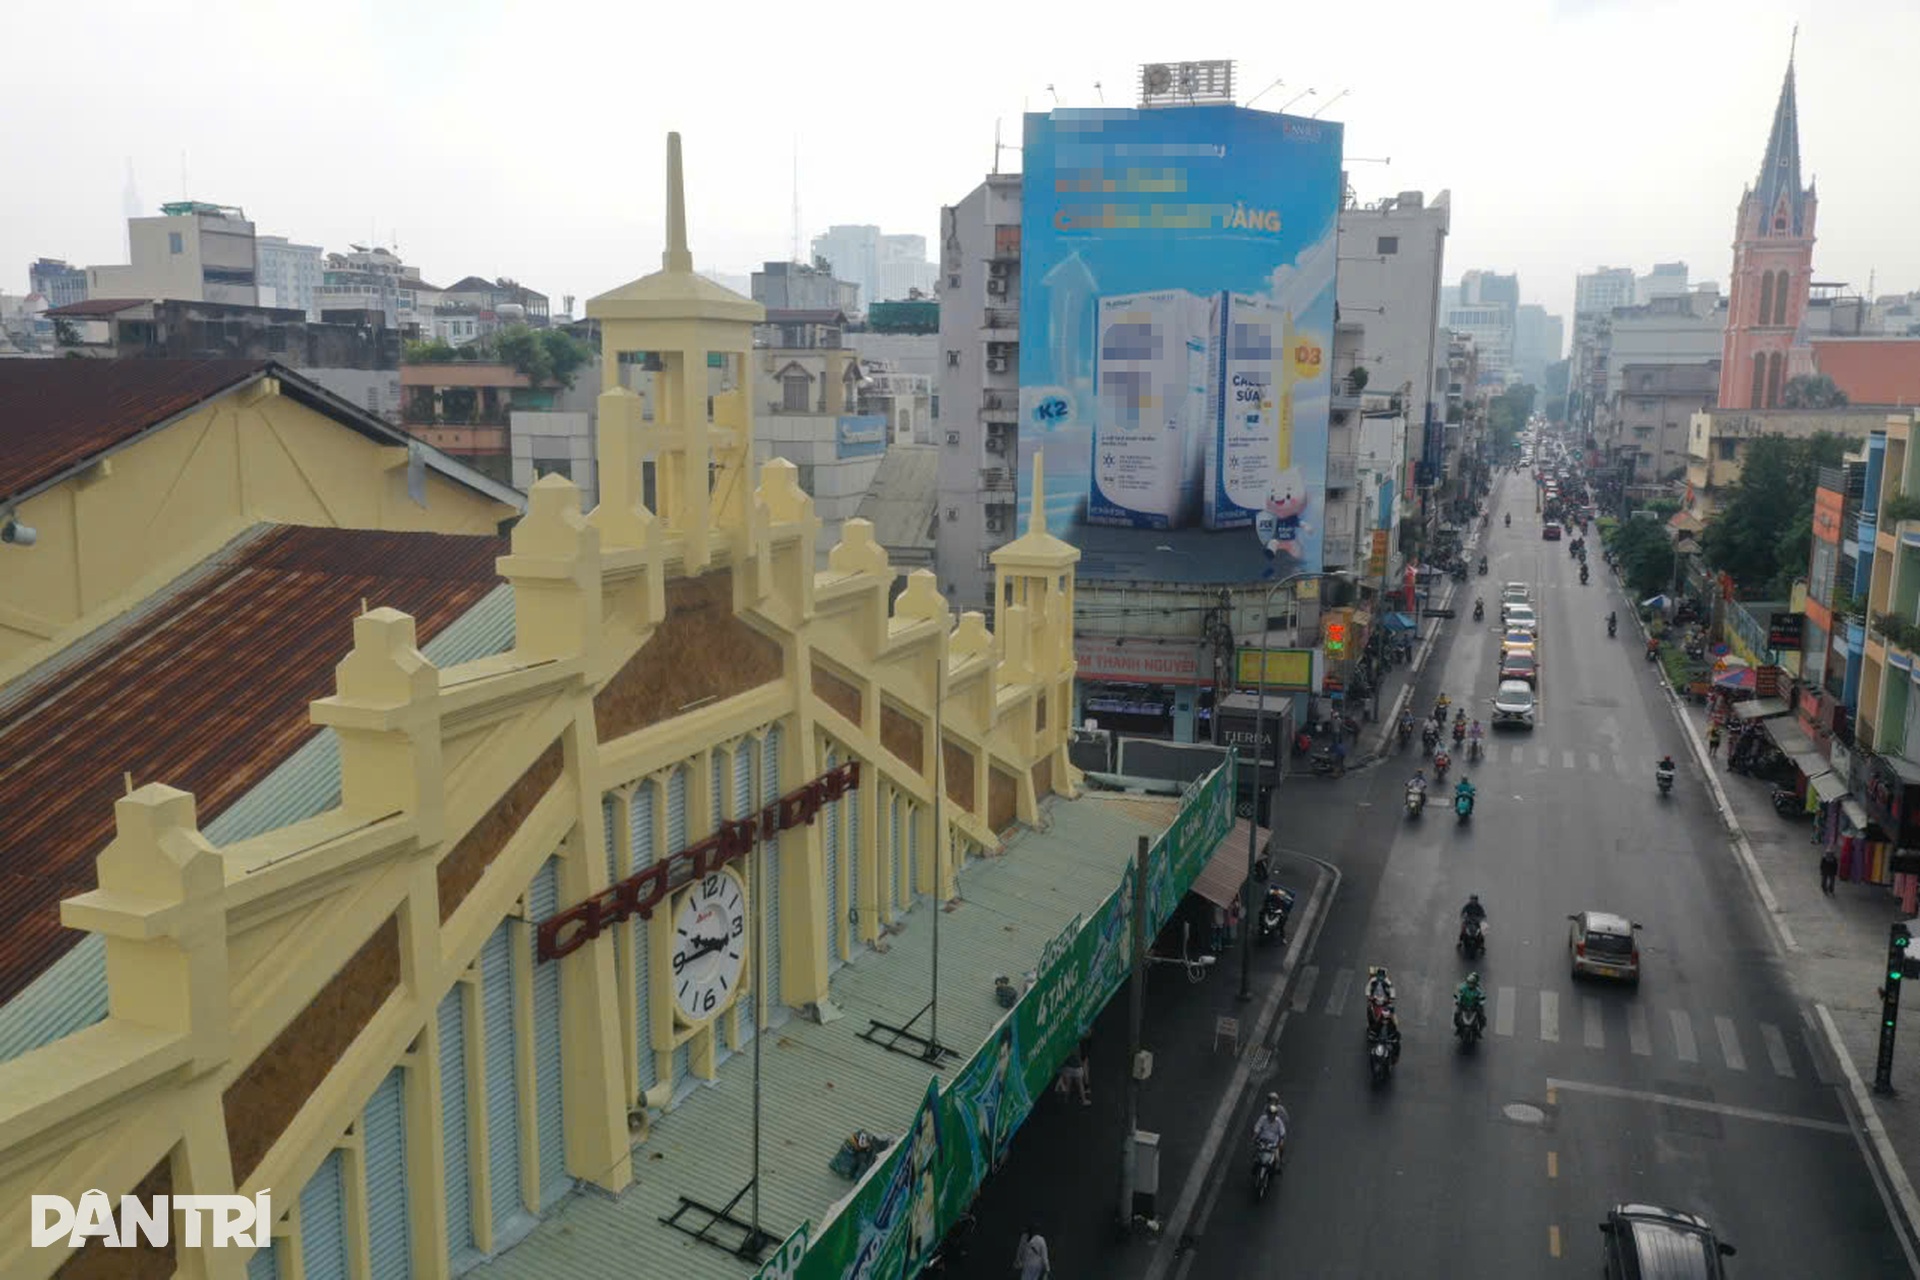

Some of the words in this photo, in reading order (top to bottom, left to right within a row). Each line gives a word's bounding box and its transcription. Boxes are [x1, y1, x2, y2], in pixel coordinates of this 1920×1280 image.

[1039, 401, 1068, 419] K2
[1096, 656, 1140, 672] THANH
[1223, 730, 1272, 745] TIERRA
[702, 875, 718, 899] 12
[732, 915, 743, 938] 3
[673, 951, 686, 975] 9
[703, 988, 716, 1011] 6
